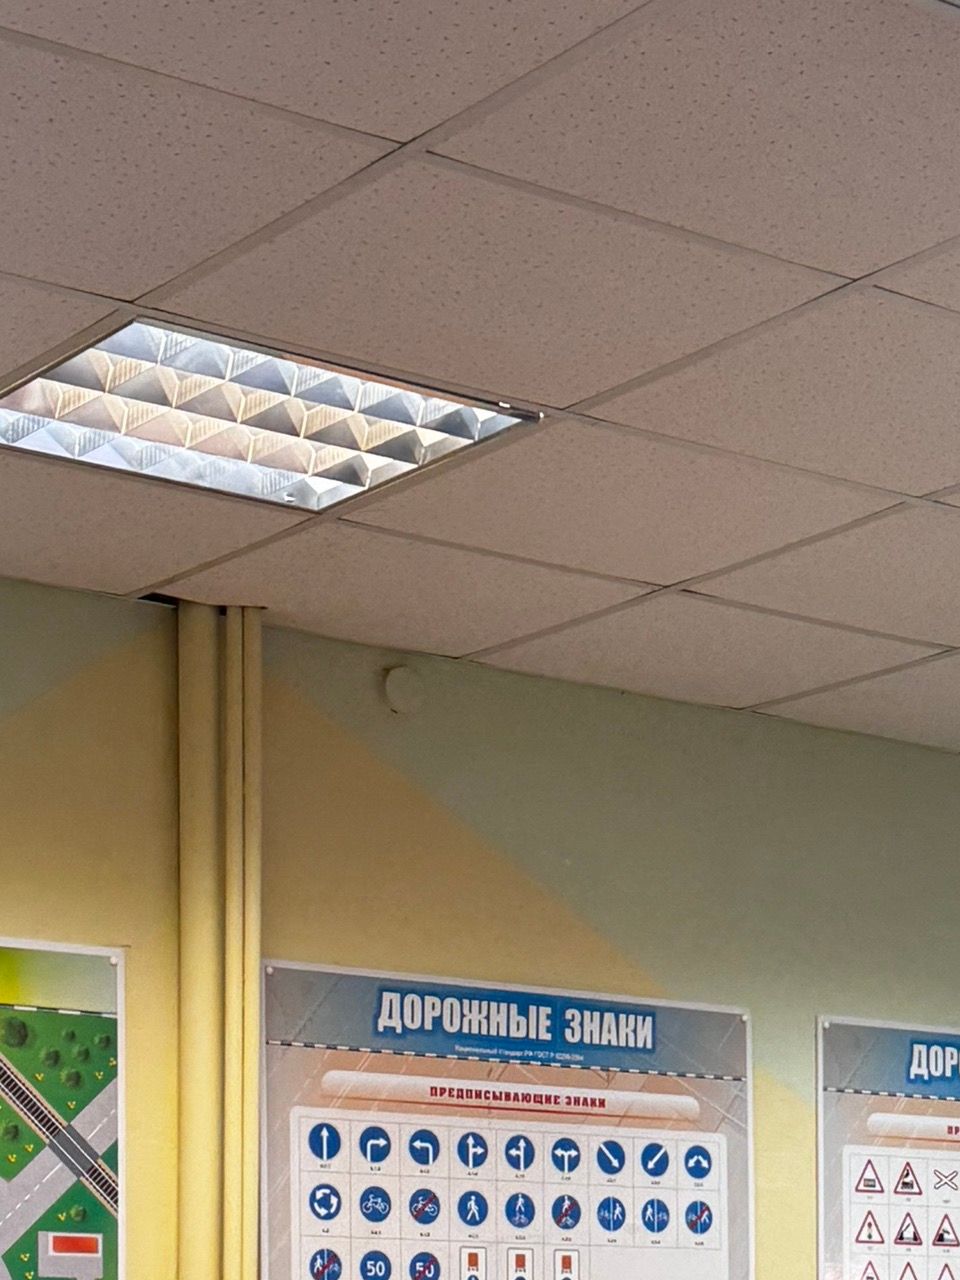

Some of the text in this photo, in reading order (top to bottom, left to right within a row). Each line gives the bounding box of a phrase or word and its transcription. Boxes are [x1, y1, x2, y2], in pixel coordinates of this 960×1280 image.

[378, 992, 652, 1049] ДОРОЖНЫЕ ЗНАКИ
[430, 1085, 606, 1109] ПРЕДПИСЫВАЮЩИЕ ЗНАКИ
[366, 1261, 385, 1276] 50
